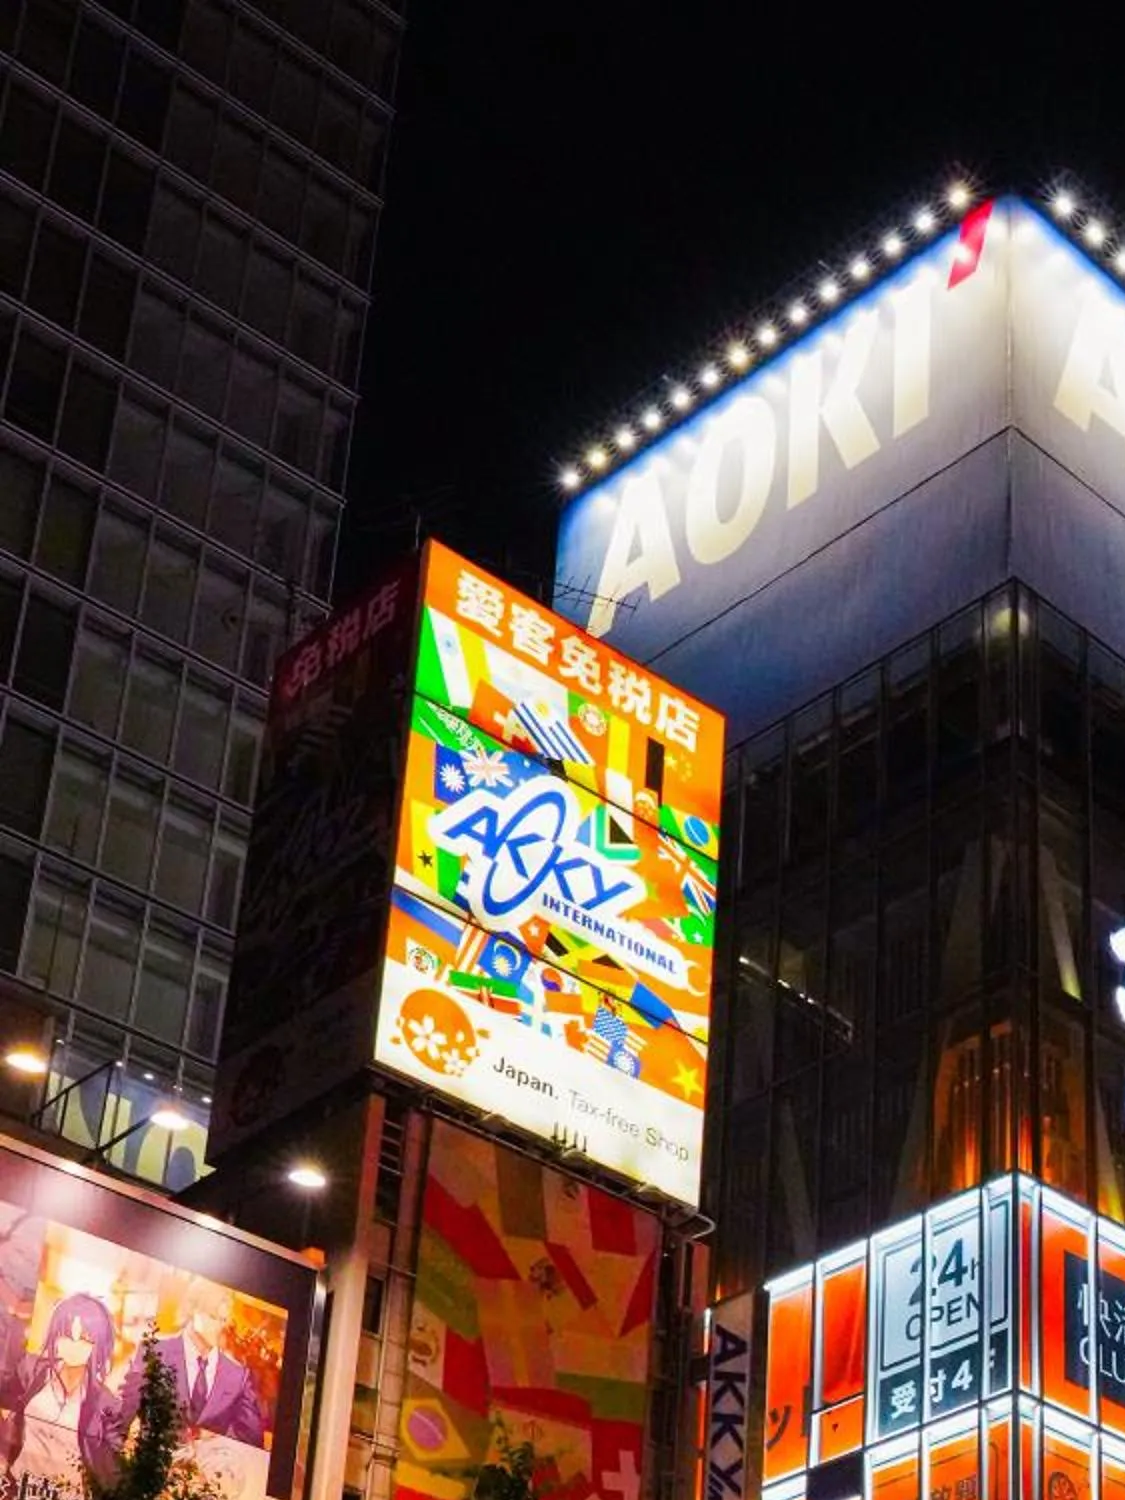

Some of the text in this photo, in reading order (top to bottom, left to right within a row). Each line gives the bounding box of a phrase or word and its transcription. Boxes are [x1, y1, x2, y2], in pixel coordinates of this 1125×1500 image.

[587, 275, 934, 638] AOKI
[455, 567, 701, 753] 愛客免税店
[541, 892, 679, 976] INTERNATIONAL
[492, 1055, 691, 1164] Japan. Tax-free Shop
[708, 1322, 749, 1499] AKKY
